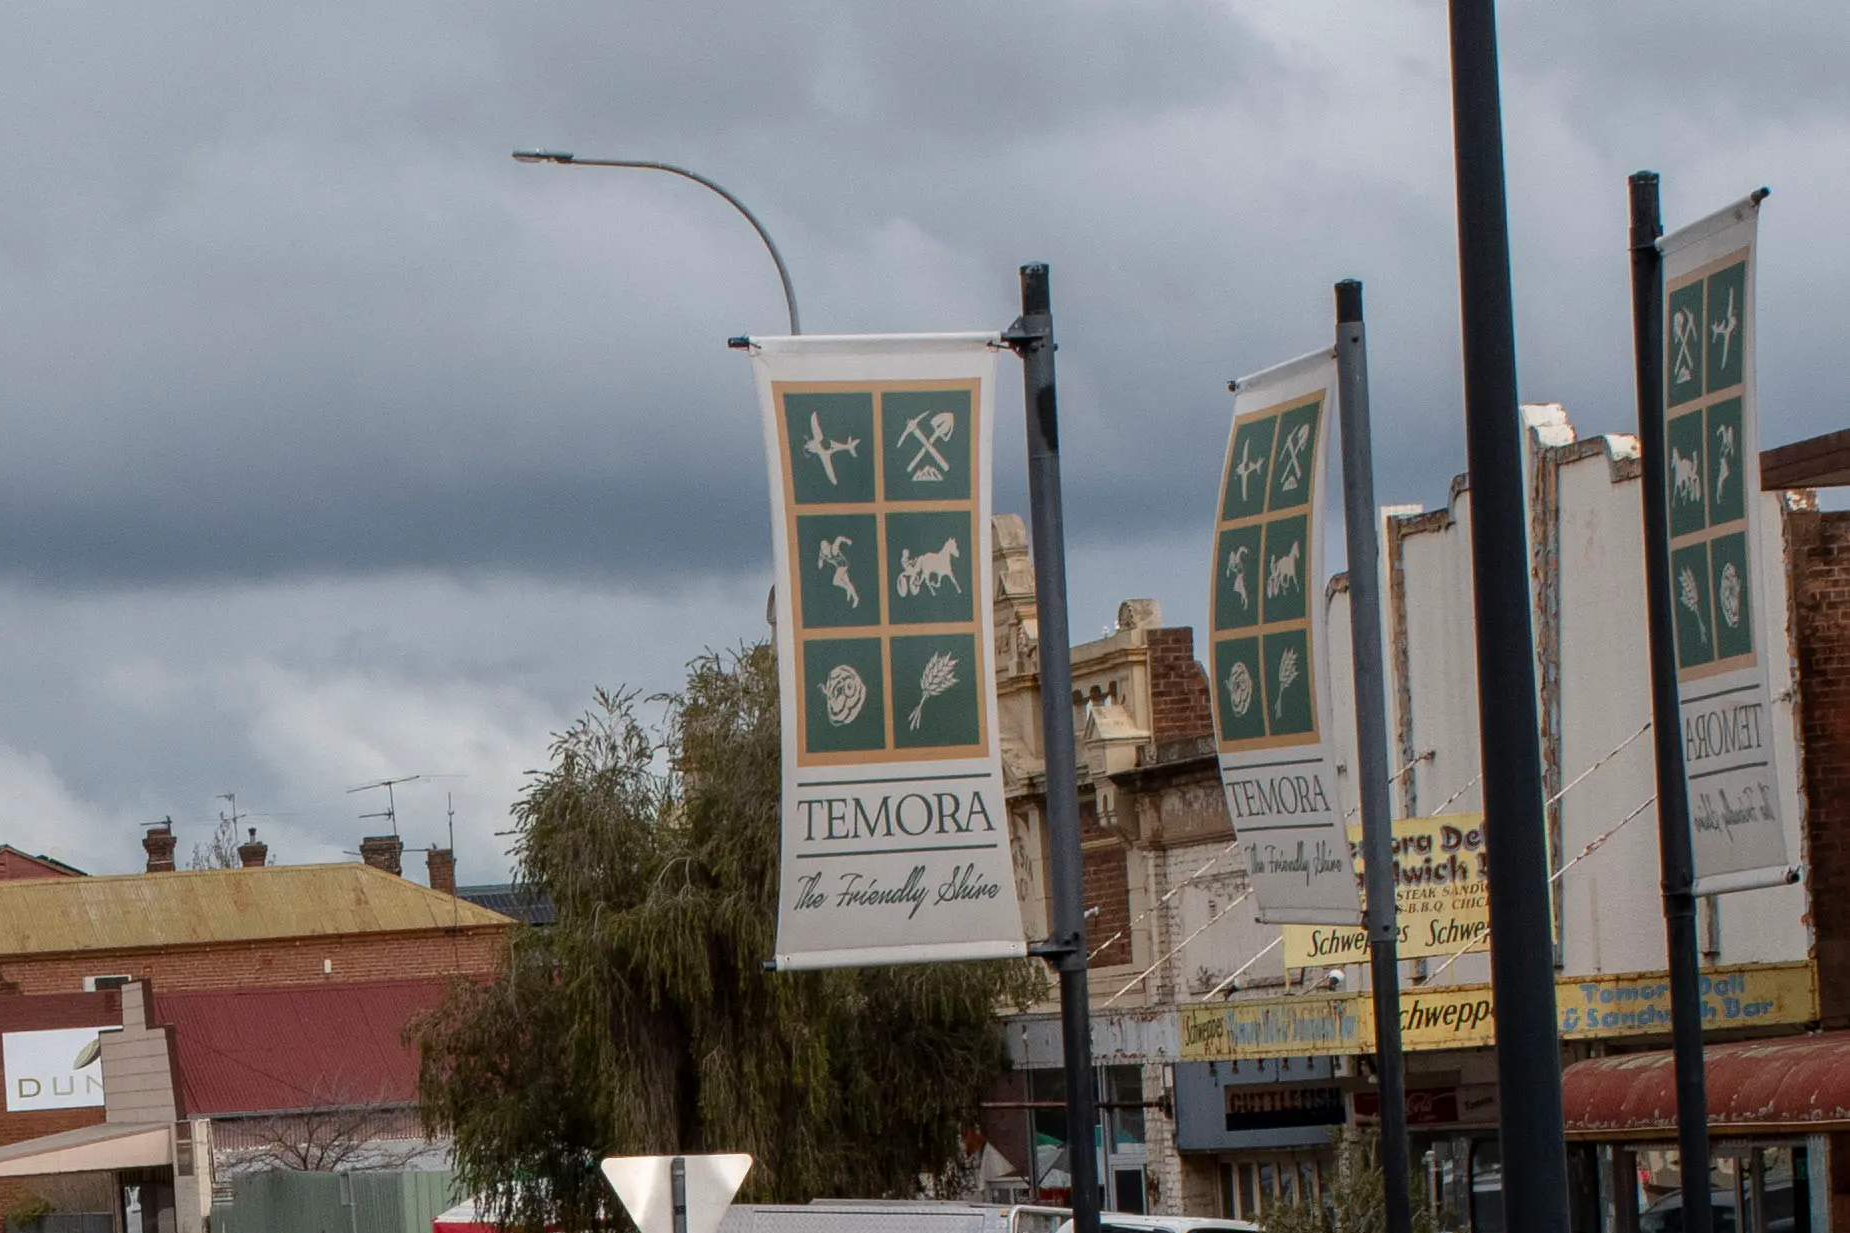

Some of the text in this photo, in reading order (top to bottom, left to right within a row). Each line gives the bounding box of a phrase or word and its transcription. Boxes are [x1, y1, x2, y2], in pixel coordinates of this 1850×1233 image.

[797, 791, 996, 841] TEMORA
[1225, 775, 1331, 818] TEMORA
[794, 871, 828, 911] The
[837, 865, 929, 920] Friendly
[934, 862, 1000, 905] Shire
[1722, 998, 1773, 1018] Bar
[1229, 1087, 1341, 1113] CUTTLEFISH
